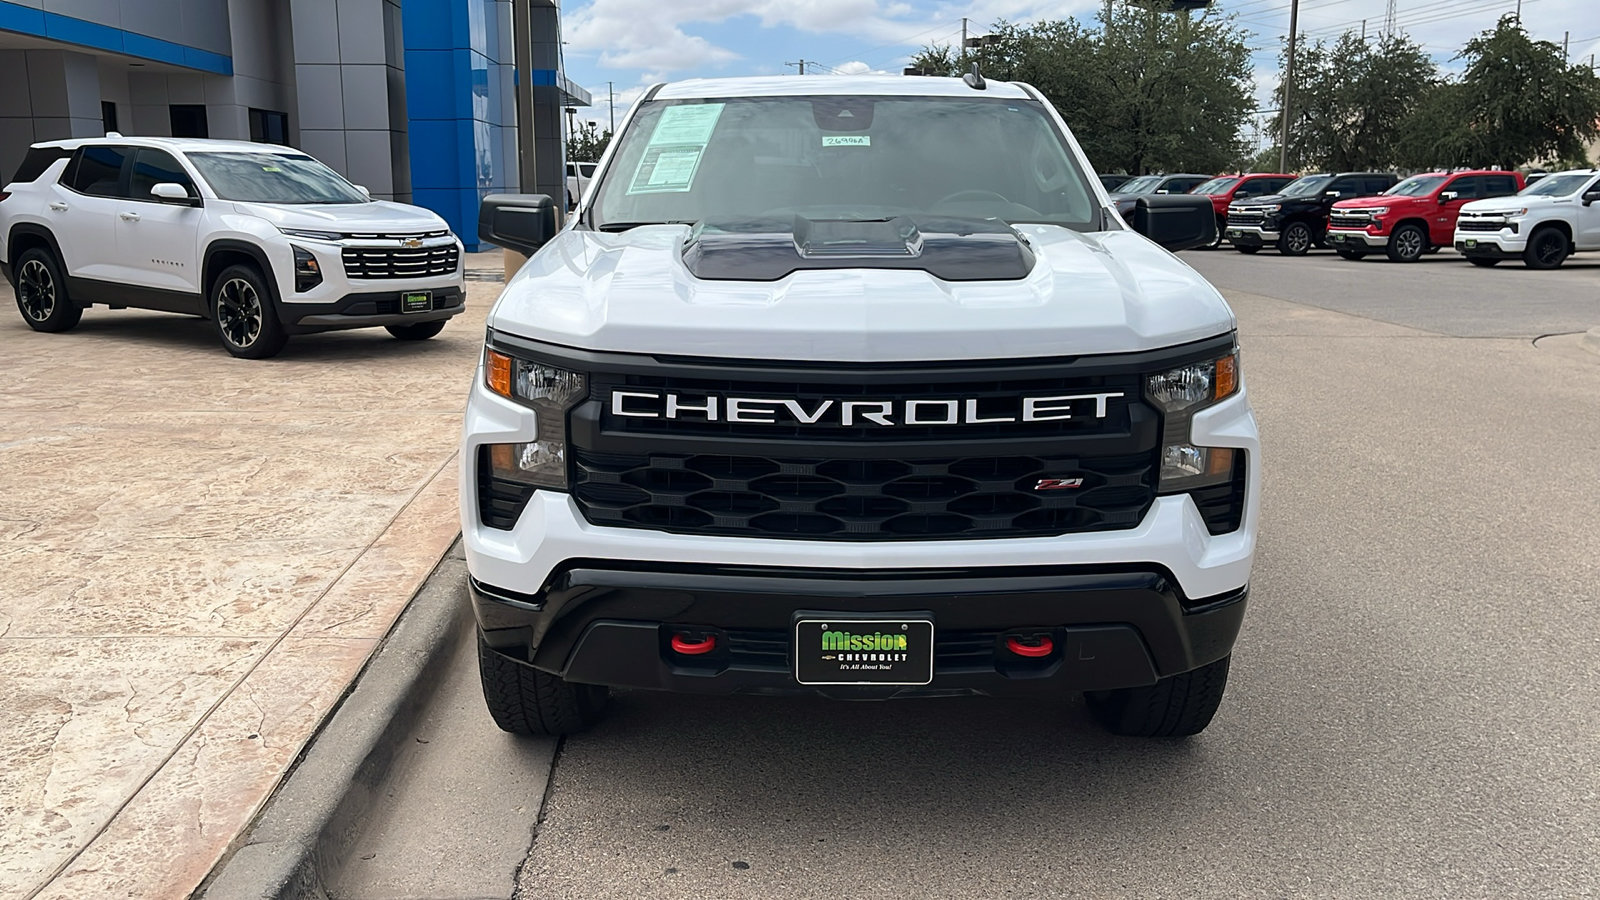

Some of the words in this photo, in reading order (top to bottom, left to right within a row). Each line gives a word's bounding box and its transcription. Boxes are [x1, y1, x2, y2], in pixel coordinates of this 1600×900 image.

[612, 391, 1124, 426] CHEVROLET
[1034, 478, 1083, 490] Z71
[822, 631, 907, 651] Mission
[838, 653, 907, 662] CHEVROLET
